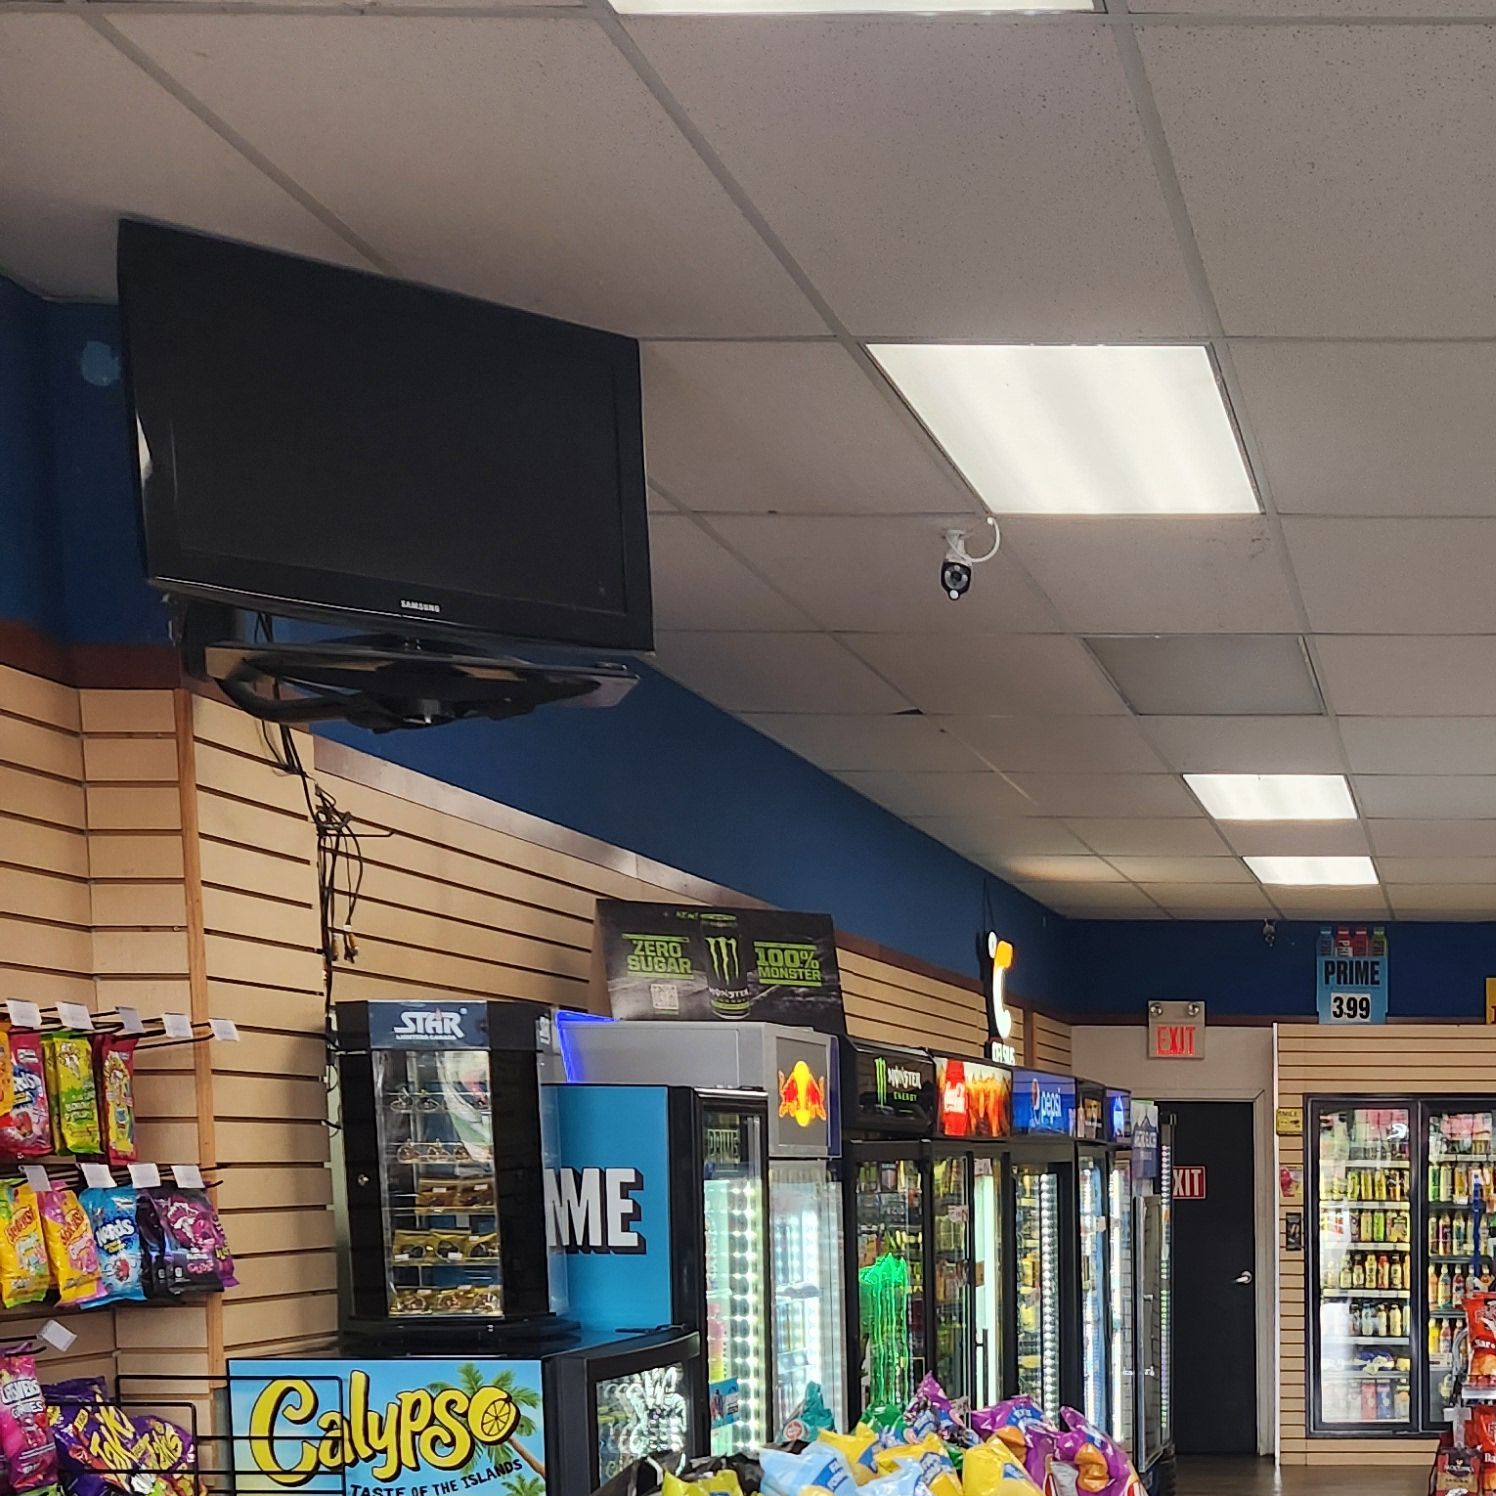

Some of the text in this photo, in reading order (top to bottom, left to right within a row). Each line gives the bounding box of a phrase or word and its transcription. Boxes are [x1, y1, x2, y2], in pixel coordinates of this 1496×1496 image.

[633, 940, 682, 958] ZERO
[755, 947, 819, 970] 100%
[627, 956, 692, 974] SUGAR
[758, 967, 821, 981] MONSTER
[1324, 960, 1381, 986] PRIME
[394, 1010, 465, 1039] STAR
[1157, 1026, 1194, 1055] EXIT
[887, 1066, 921, 1090] MONSTER
[1041, 1087, 1062, 1124] pepsi
[1172, 1168, 1203, 1198] XIT
[250, 1370, 520, 1487] Calypso
[432, 1480, 458, 1496] THE
[463, 1459, 523, 1489] ISLANDS
